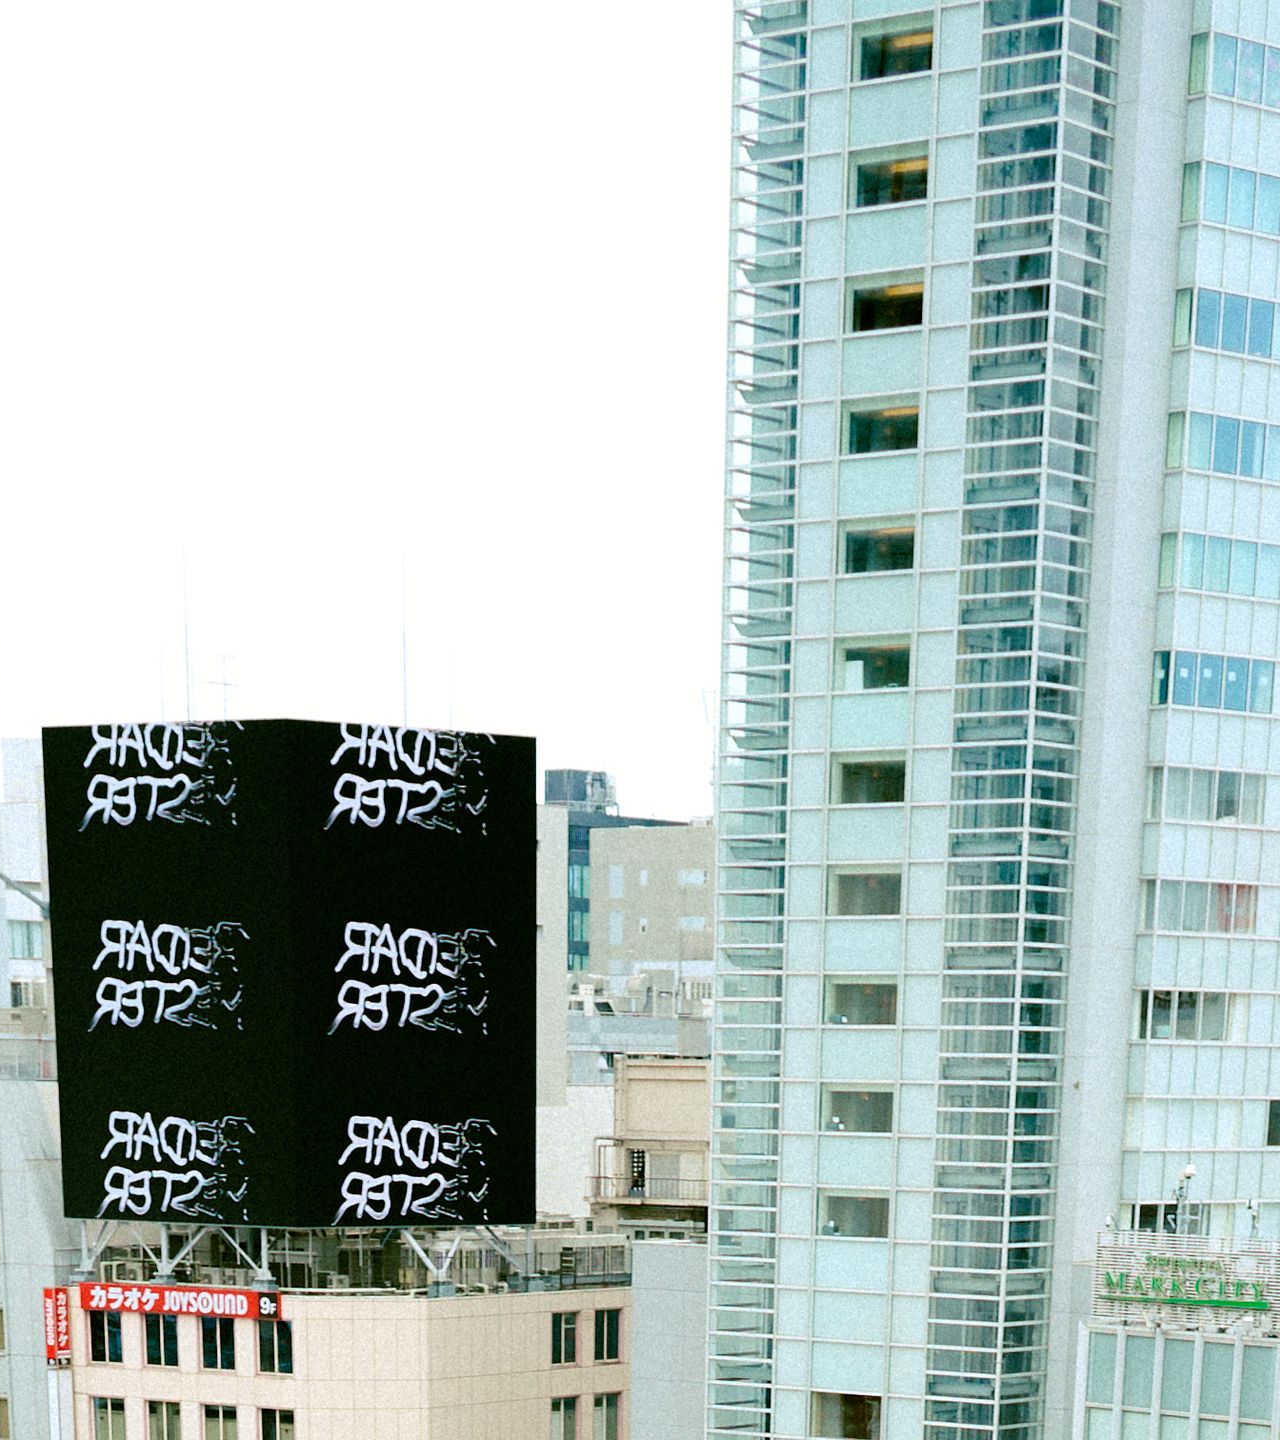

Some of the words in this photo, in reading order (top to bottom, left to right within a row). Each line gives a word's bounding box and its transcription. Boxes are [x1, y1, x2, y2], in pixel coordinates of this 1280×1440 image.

[57, 1291, 68, 1347] カラオケ
[90, 1286, 159, 1310] カラオケ
[163, 1291, 248, 1315] JOYSOUND
[259, 1294, 276, 1314] 9F
